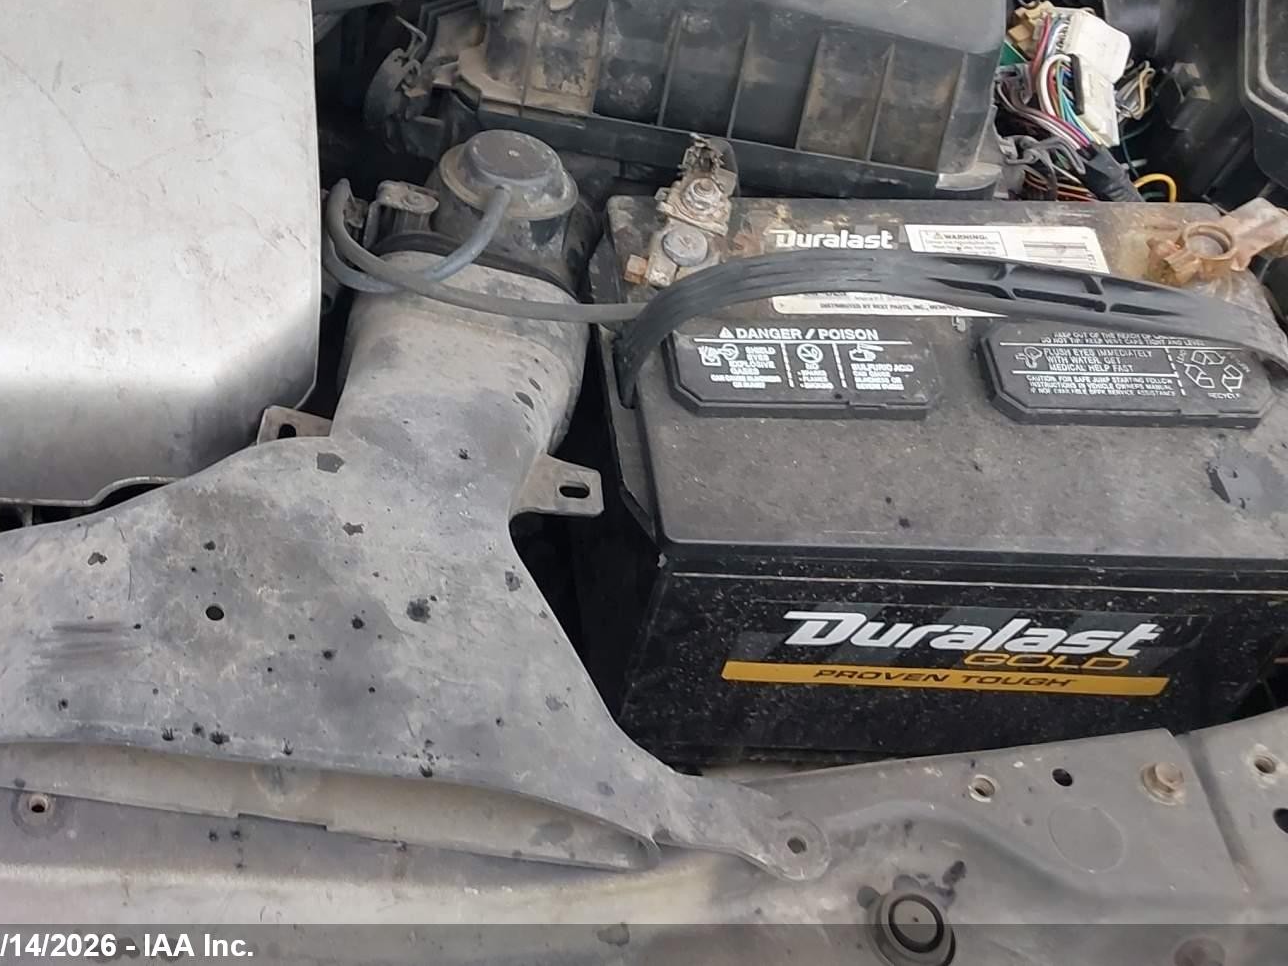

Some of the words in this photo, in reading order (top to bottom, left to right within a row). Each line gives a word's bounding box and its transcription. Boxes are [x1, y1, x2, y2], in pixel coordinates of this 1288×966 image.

[769, 229, 894, 250] Duralast
[736, 328, 802, 339] DANGER
[819, 329, 879, 340] POISON
[1043, 348, 1071, 356] FLUSH
[1072, 348, 1094, 356] EYES
[1096, 349, 1152, 358] IMMEDIATELY
[1047, 356, 1069, 364] WITH
[1049, 364, 1087, 372] MEDICAL
[1088, 364, 1110, 372] HELP
[783, 611, 1160, 656] Duralast
[962, 653, 1129, 671] GOLD
[814, 668, 948, 683] PROVEN
[962, 674, 1074, 688] TOUGH
